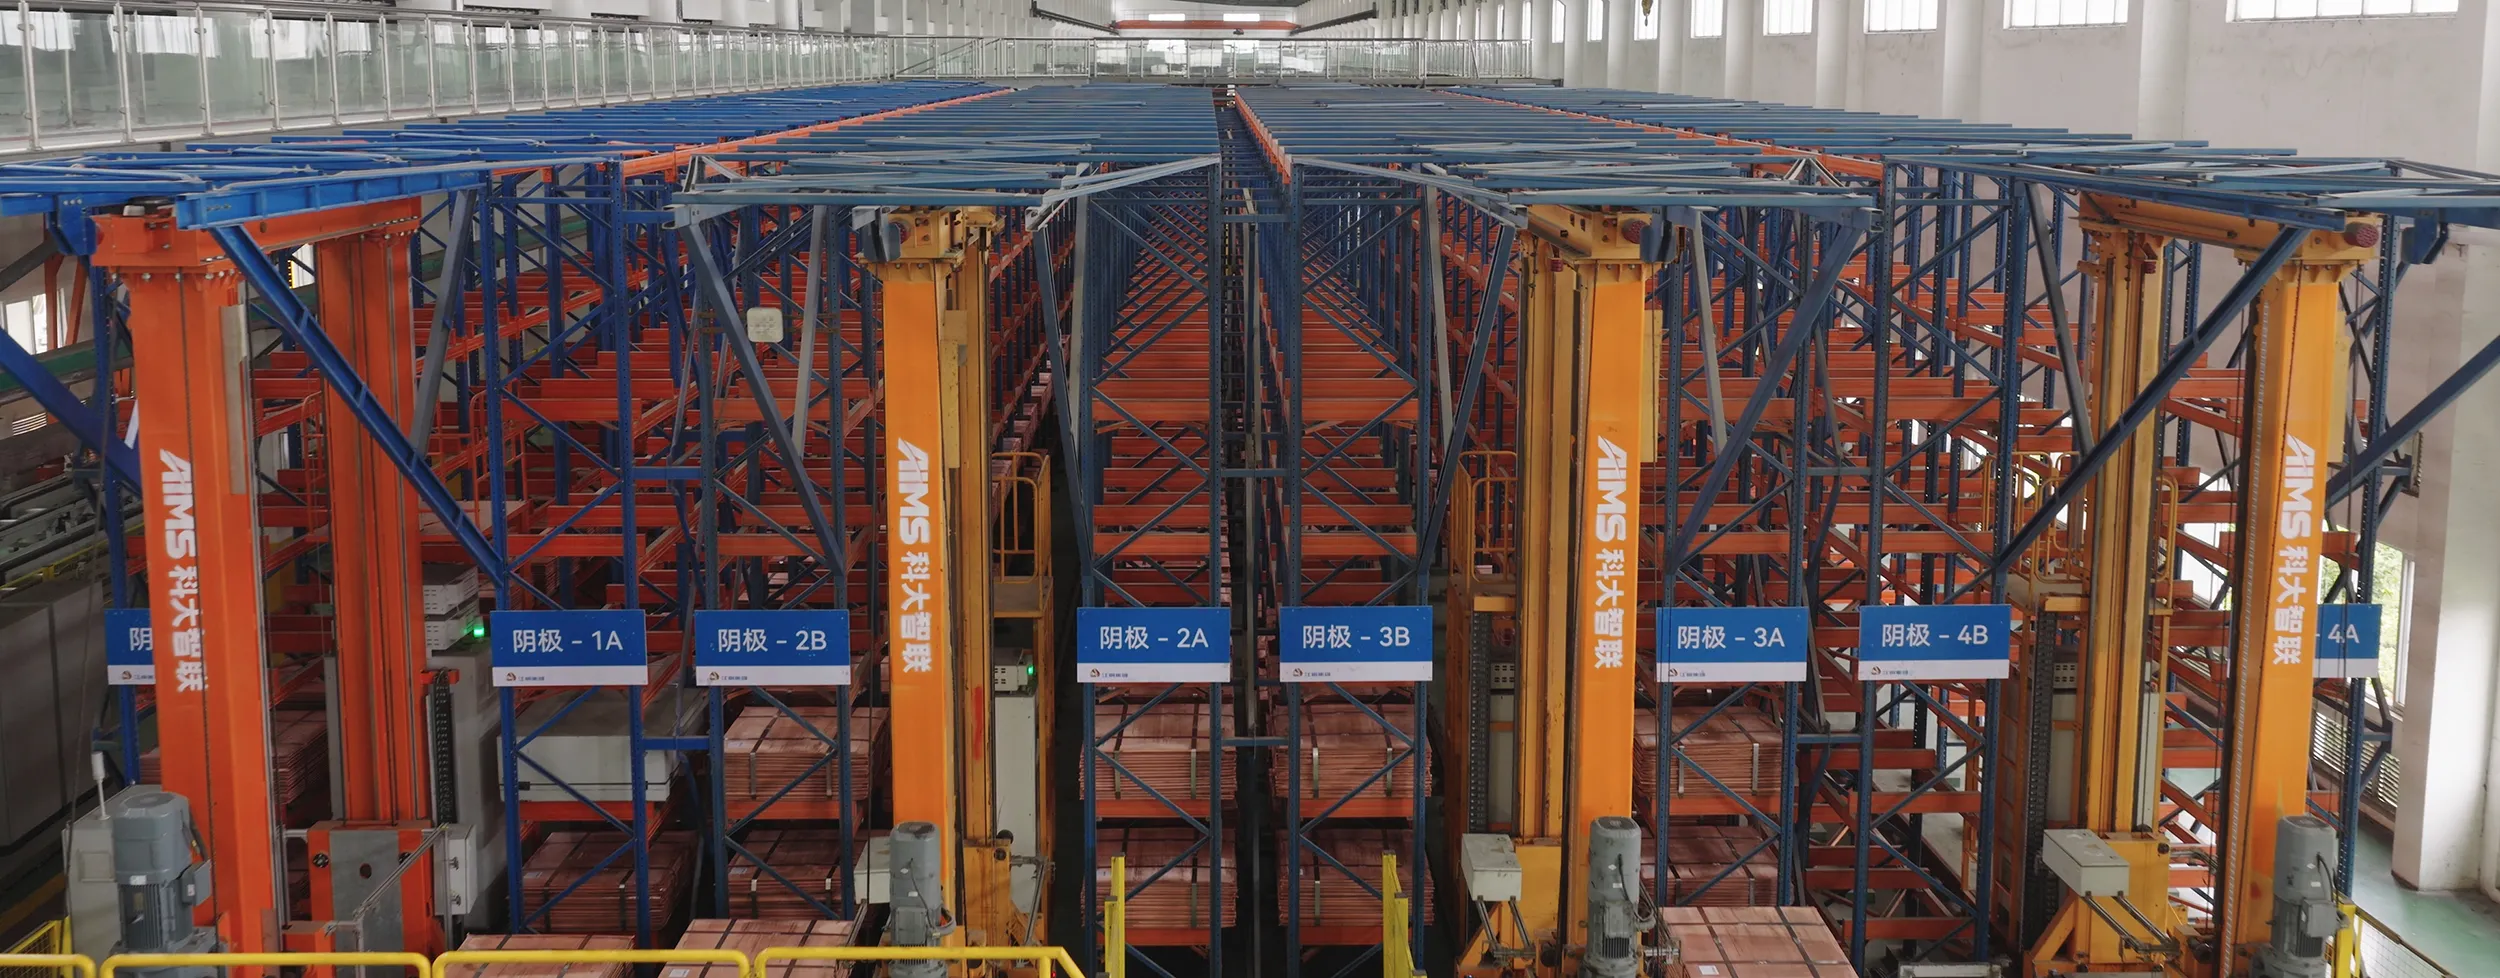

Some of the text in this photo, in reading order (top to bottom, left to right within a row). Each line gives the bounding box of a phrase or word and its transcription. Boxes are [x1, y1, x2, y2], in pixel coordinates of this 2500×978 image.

[897, 437, 933, 673] AIMS 科大智联
[1593, 435, 1627, 669] AIMS 科大智联
[2272, 433, 2316, 665] AIMS 科大智联
[159, 448, 209, 693] AIMS 科大智联
[512, 628, 564, 653] 阴极
[591, 630, 624, 651] 1A
[717, 628, 768, 652] 阴极
[795, 630, 827, 651] 2B
[1100, 625, 1149, 650] 阴极
[1176, 627, 1209, 648] 2A
[1302, 624, 1352, 649] 阴极
[1379, 626, 1411, 647] 3B
[1677, 625, 1726, 649] 阴极
[1753, 627, 1785, 648] 3A
[1882, 623, 1931, 647] 阴极
[1957, 624, 1989, 645] 4B
[2327, 623, 2360, 644] 4A
